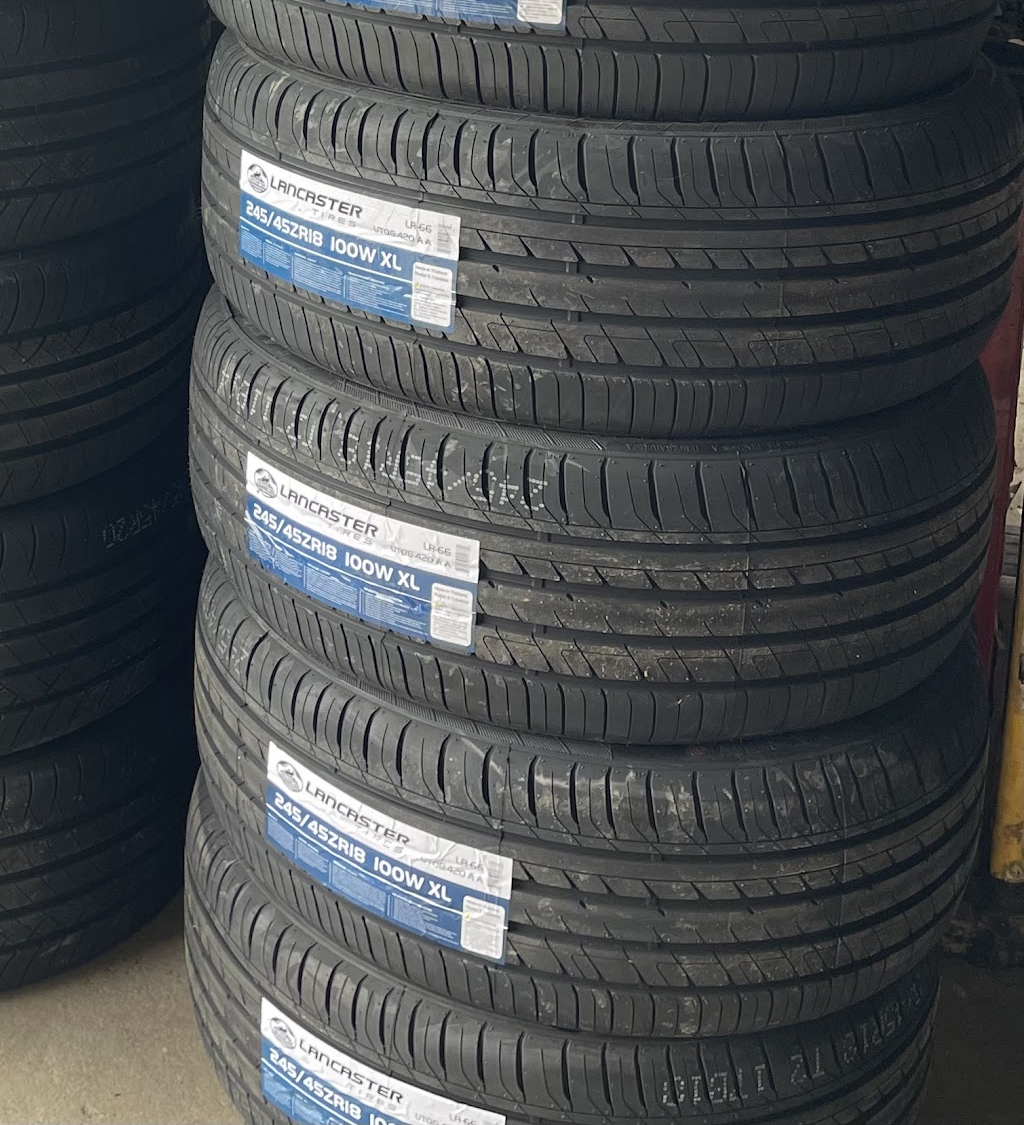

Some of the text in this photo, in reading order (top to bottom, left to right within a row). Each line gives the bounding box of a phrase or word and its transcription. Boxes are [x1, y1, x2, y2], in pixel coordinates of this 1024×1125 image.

[270, 176, 364, 219] LANCASTER
[313, 208, 357, 228] TIRES
[405, 219, 433, 234] LR-66
[246, 199, 403, 271] 245/45ZR18 100W XL
[253, 502, 421, 592] 245/45ZR18 100W XL
[279, 484, 452, 557] LANCASTER LR-66
[274, 791, 452, 903] 245/45ZR18 100W XL
[305, 780, 411, 846] LANCASTER
[268, 1046, 362, 1120] 245/45ZR18
[299, 1038, 404, 1105] LANCASTER
